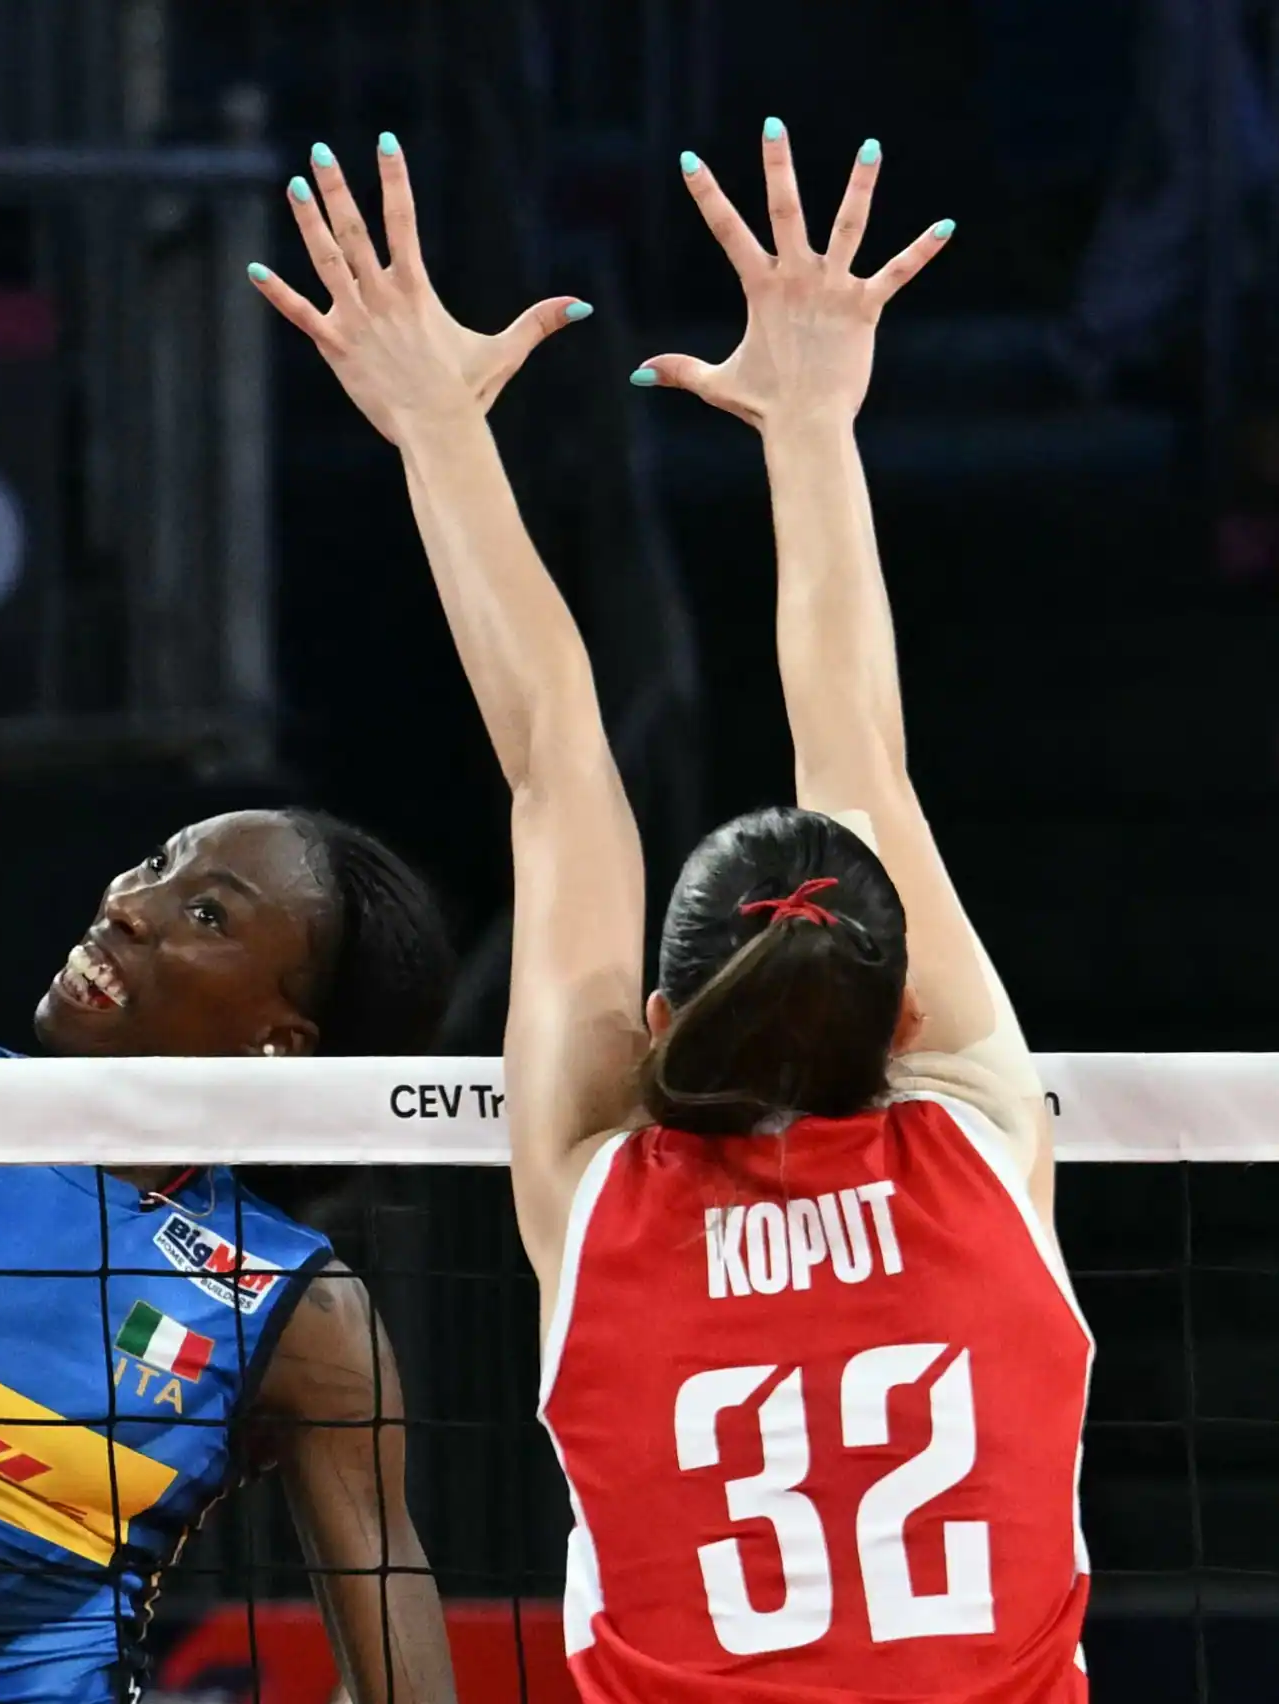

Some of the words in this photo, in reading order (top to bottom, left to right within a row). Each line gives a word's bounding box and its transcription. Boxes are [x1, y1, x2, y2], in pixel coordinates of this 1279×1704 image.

[389, 1084, 463, 1119] CEV
[704, 1180, 904, 1299] KOPUT
[200, 1277, 253, 1309] BUILDRS
[113, 1357, 183, 1415] ITA
[674, 1342, 996, 1656] 32
